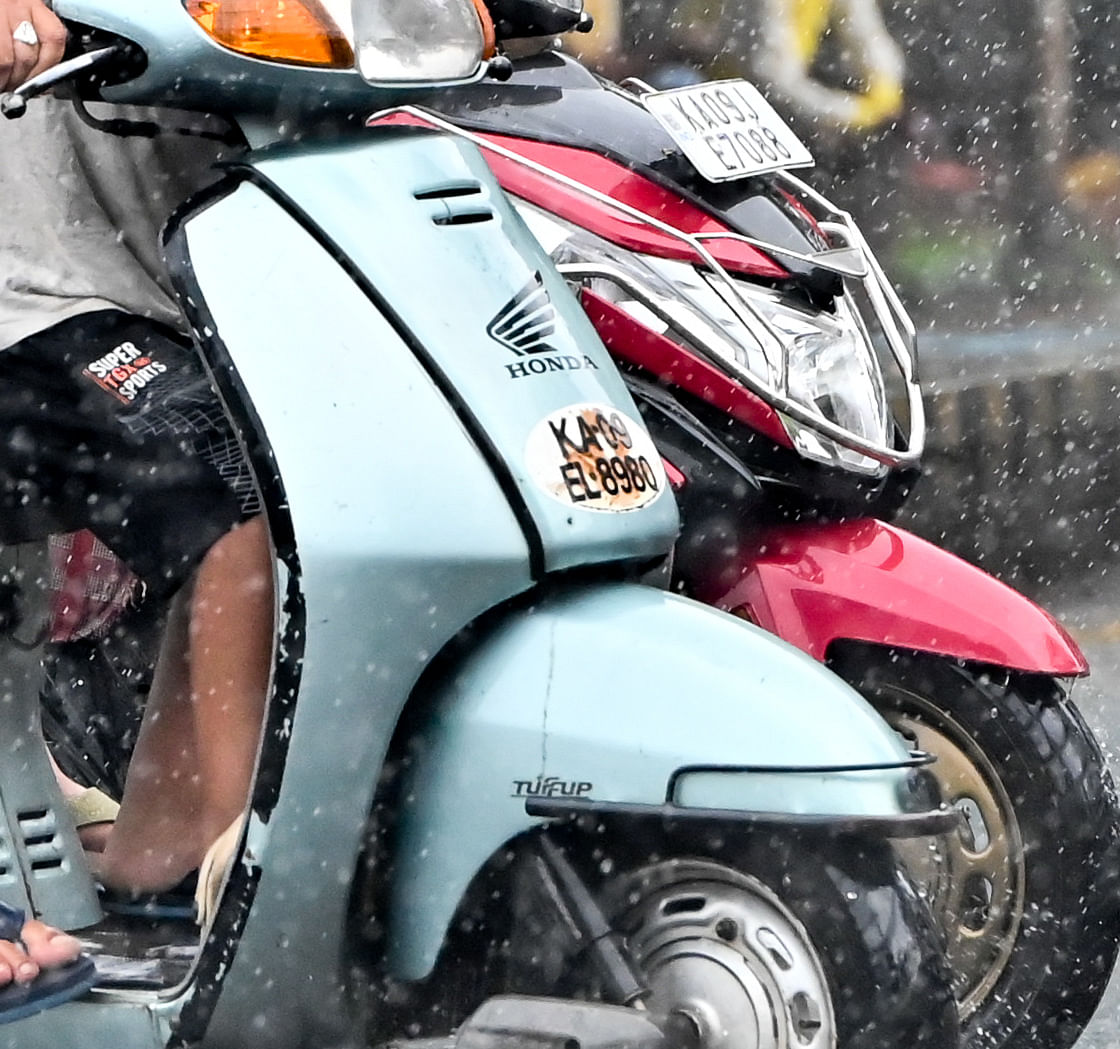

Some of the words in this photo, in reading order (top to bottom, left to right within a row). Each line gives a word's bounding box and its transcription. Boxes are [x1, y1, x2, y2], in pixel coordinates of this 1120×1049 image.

[88, 341, 142, 378] SUPER
[504, 355, 599, 379] HONDA
[119, 360, 167, 400] SPORTS
